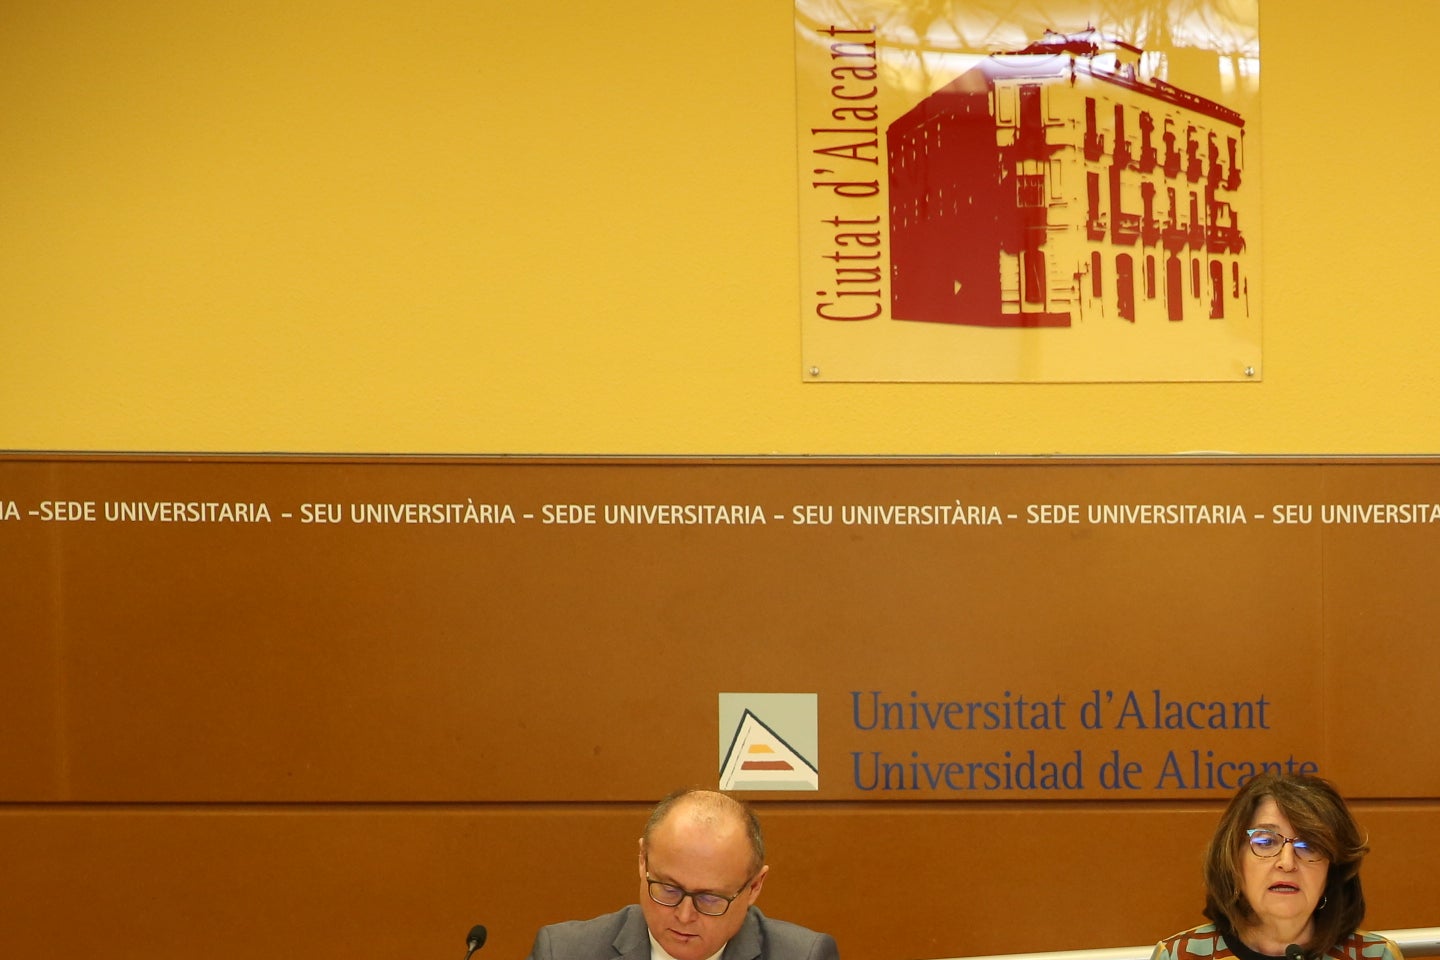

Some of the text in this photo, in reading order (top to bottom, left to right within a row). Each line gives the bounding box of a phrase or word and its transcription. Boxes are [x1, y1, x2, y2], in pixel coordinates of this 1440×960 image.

[811, 25, 882, 322] Ciutat d'Alacant
[104, 502, 272, 522] UNIVERSITARIA
[300, 504, 342, 523] SEU
[351, 498, 516, 524] UNIVERSITÀRIA
[542, 505, 596, 524] SEDE
[604, 505, 767, 524] UNIVERSITARIA
[792, 505, 833, 525] SEU
[841, 499, 1002, 525] UNIVERSITÀRIA
[1026, 504, 1080, 524] SEDE
[1088, 504, 1247, 524] UNIVERSITARIA
[1272, 504, 1313, 524] SEU
[850, 689, 1271, 731] Universitat d'Alacant
[850, 750, 1084, 791] Universidad
[1099, 750, 1143, 790] de
